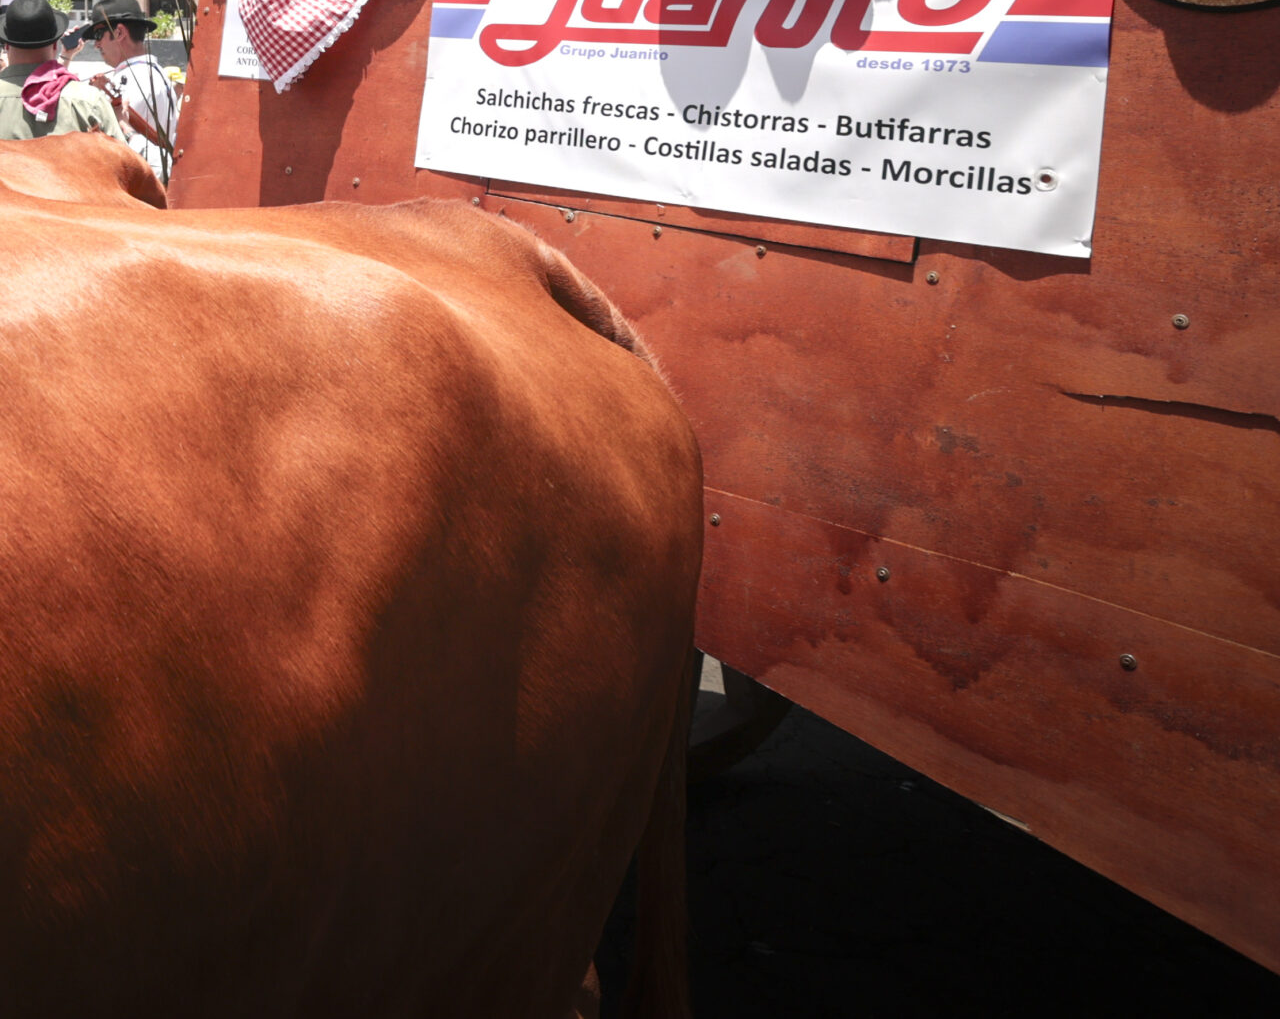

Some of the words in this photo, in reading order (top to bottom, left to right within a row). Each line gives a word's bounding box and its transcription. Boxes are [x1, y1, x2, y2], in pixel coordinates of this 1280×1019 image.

[560, 44, 605, 60] Grupo
[610, 46, 669, 61] Juanito
[236, 57, 258, 67] ANTO
[856, 56, 913, 70] desde
[920, 58, 970, 73] 1973
[476, 87, 576, 113] Salchichas
[582, 95, 660, 121] frescas
[682, 103, 809, 133] Chistorras
[836, 114, 992, 149] Butifarras
[450, 116, 519, 140] Chorizo
[524, 126, 621, 151] parrillero
[643, 136, 743, 165] Costillas
[750, 147, 851, 176] saladas
[881, 158, 1032, 195] Morcillas
